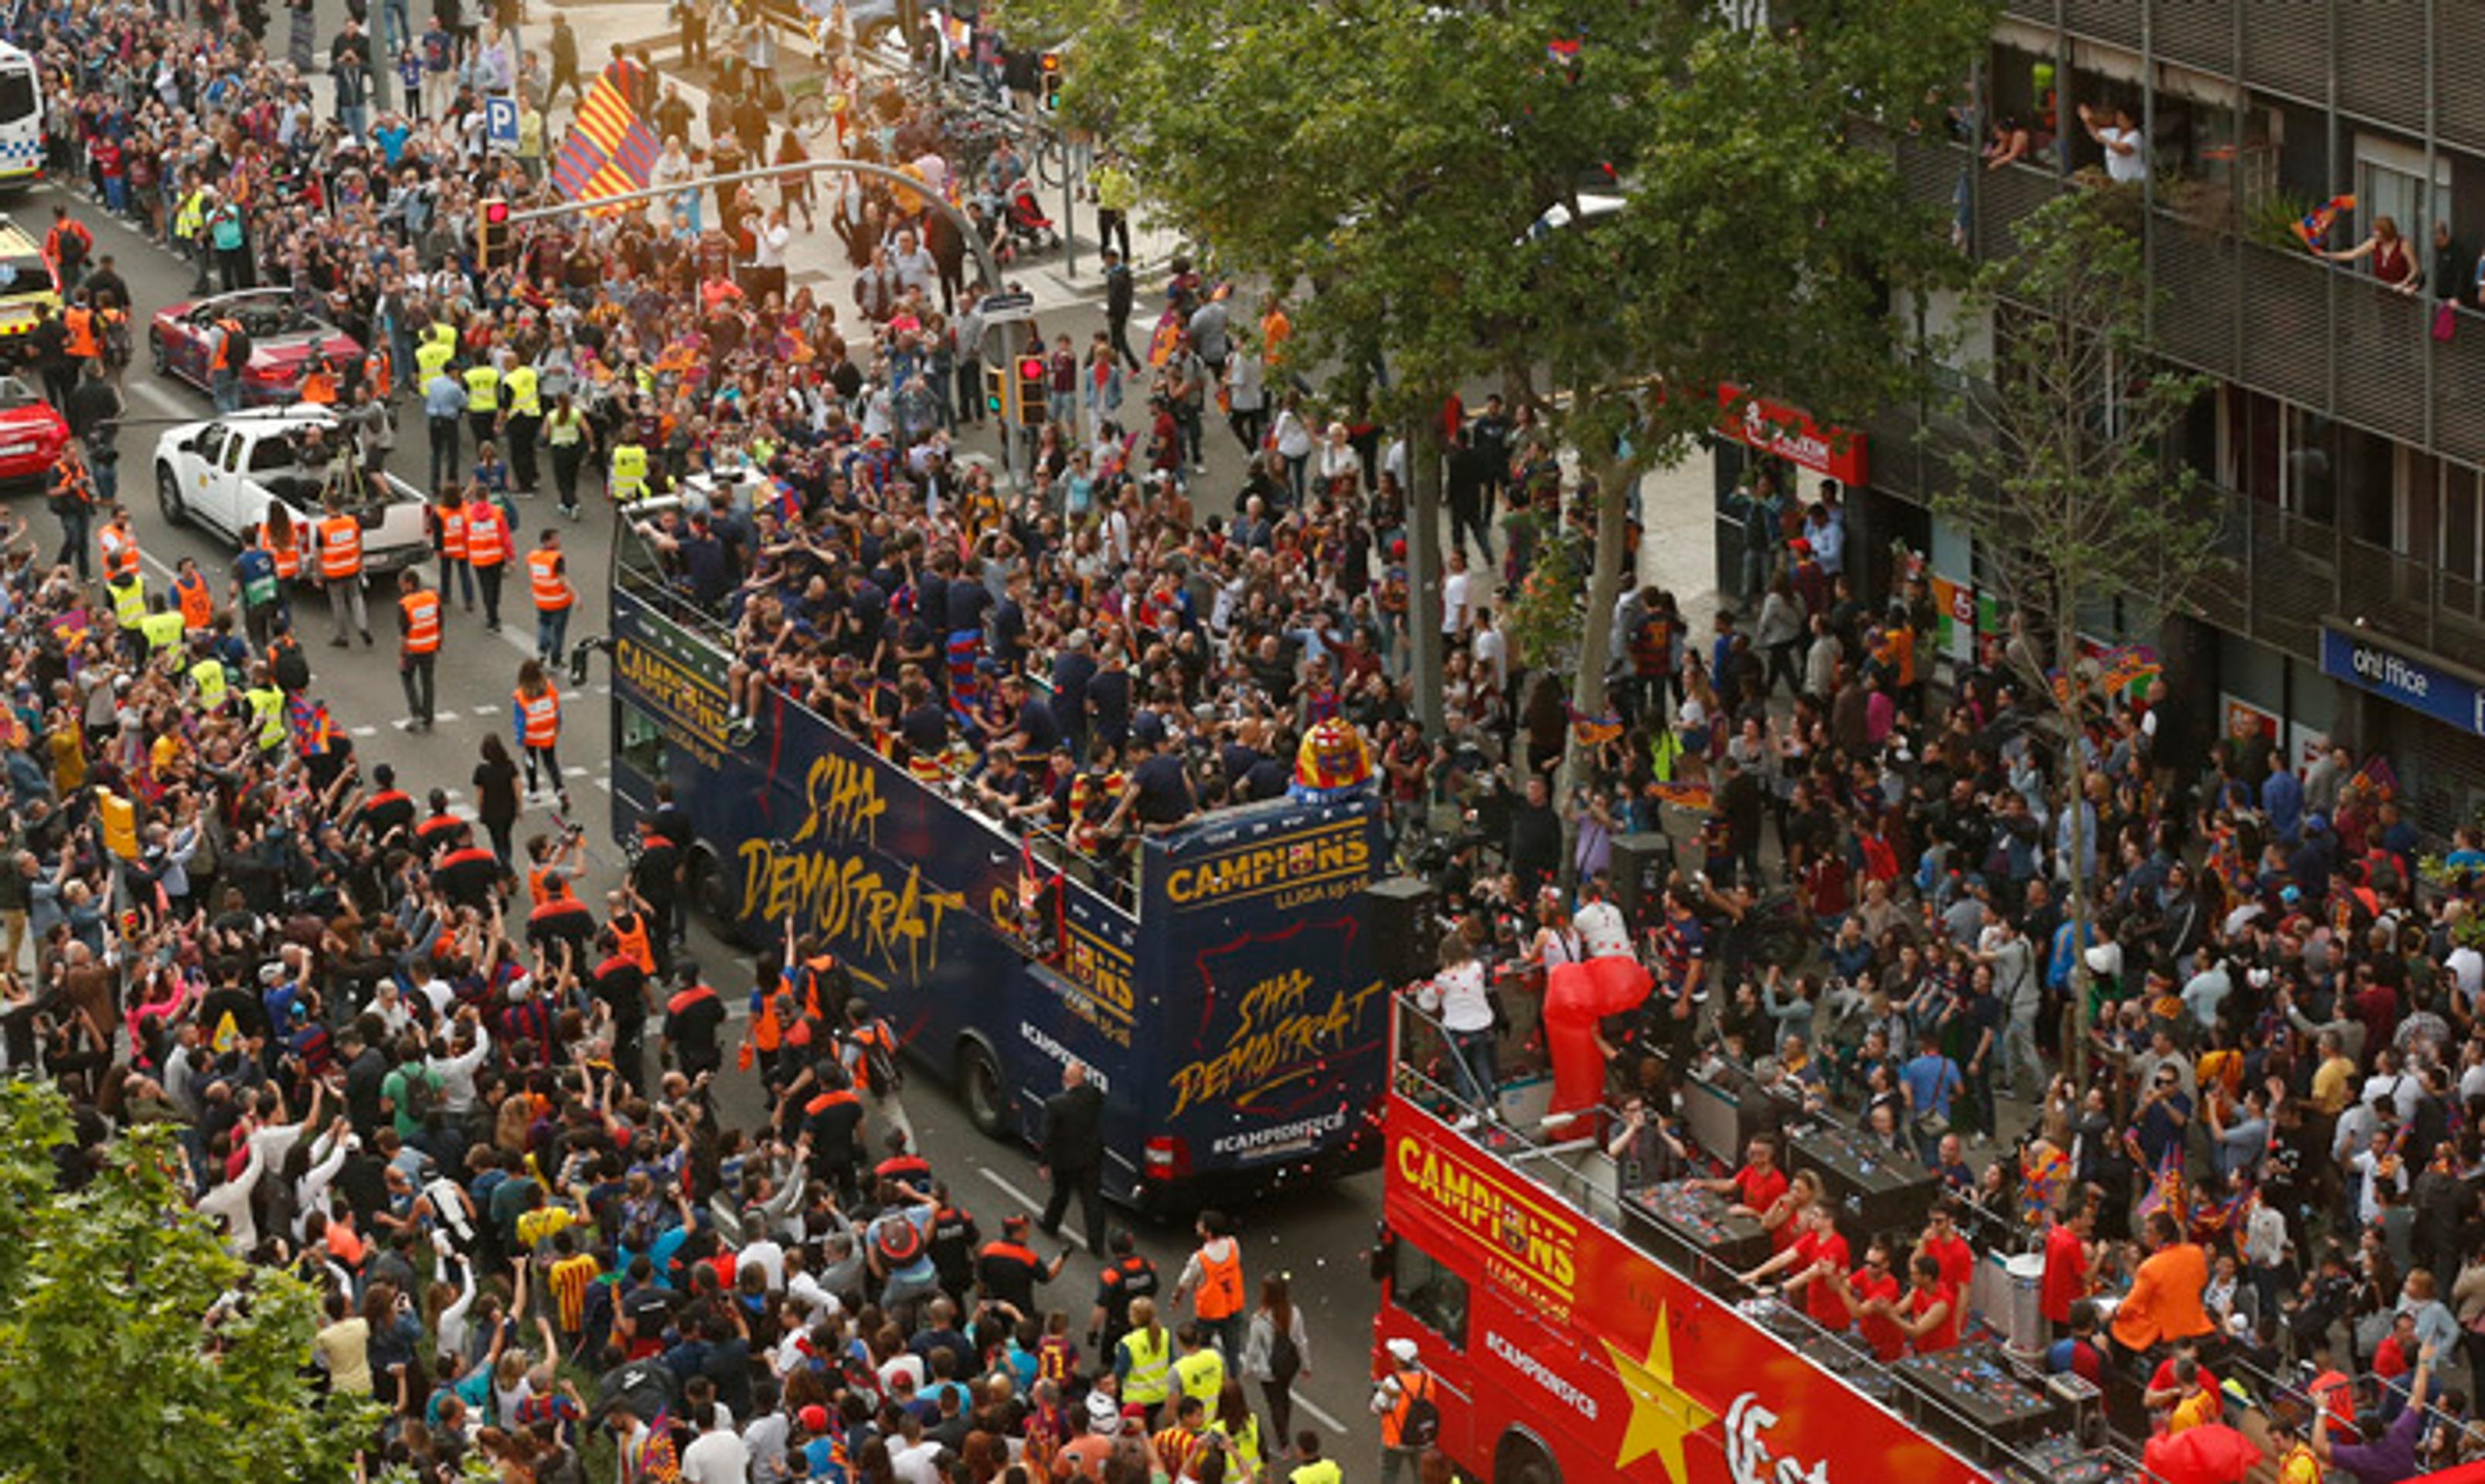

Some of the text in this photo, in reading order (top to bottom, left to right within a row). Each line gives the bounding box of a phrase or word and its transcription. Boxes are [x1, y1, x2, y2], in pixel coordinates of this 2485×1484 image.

[491, 102, 512, 134] P
[737, 838, 965, 989] DEMOSTRAT
[1166, 829, 1370, 903] CAMPIONS
[1165, 979, 1386, 1123] DEMOSTRAT
[1397, 1135, 1576, 1288] CAMPIONS
